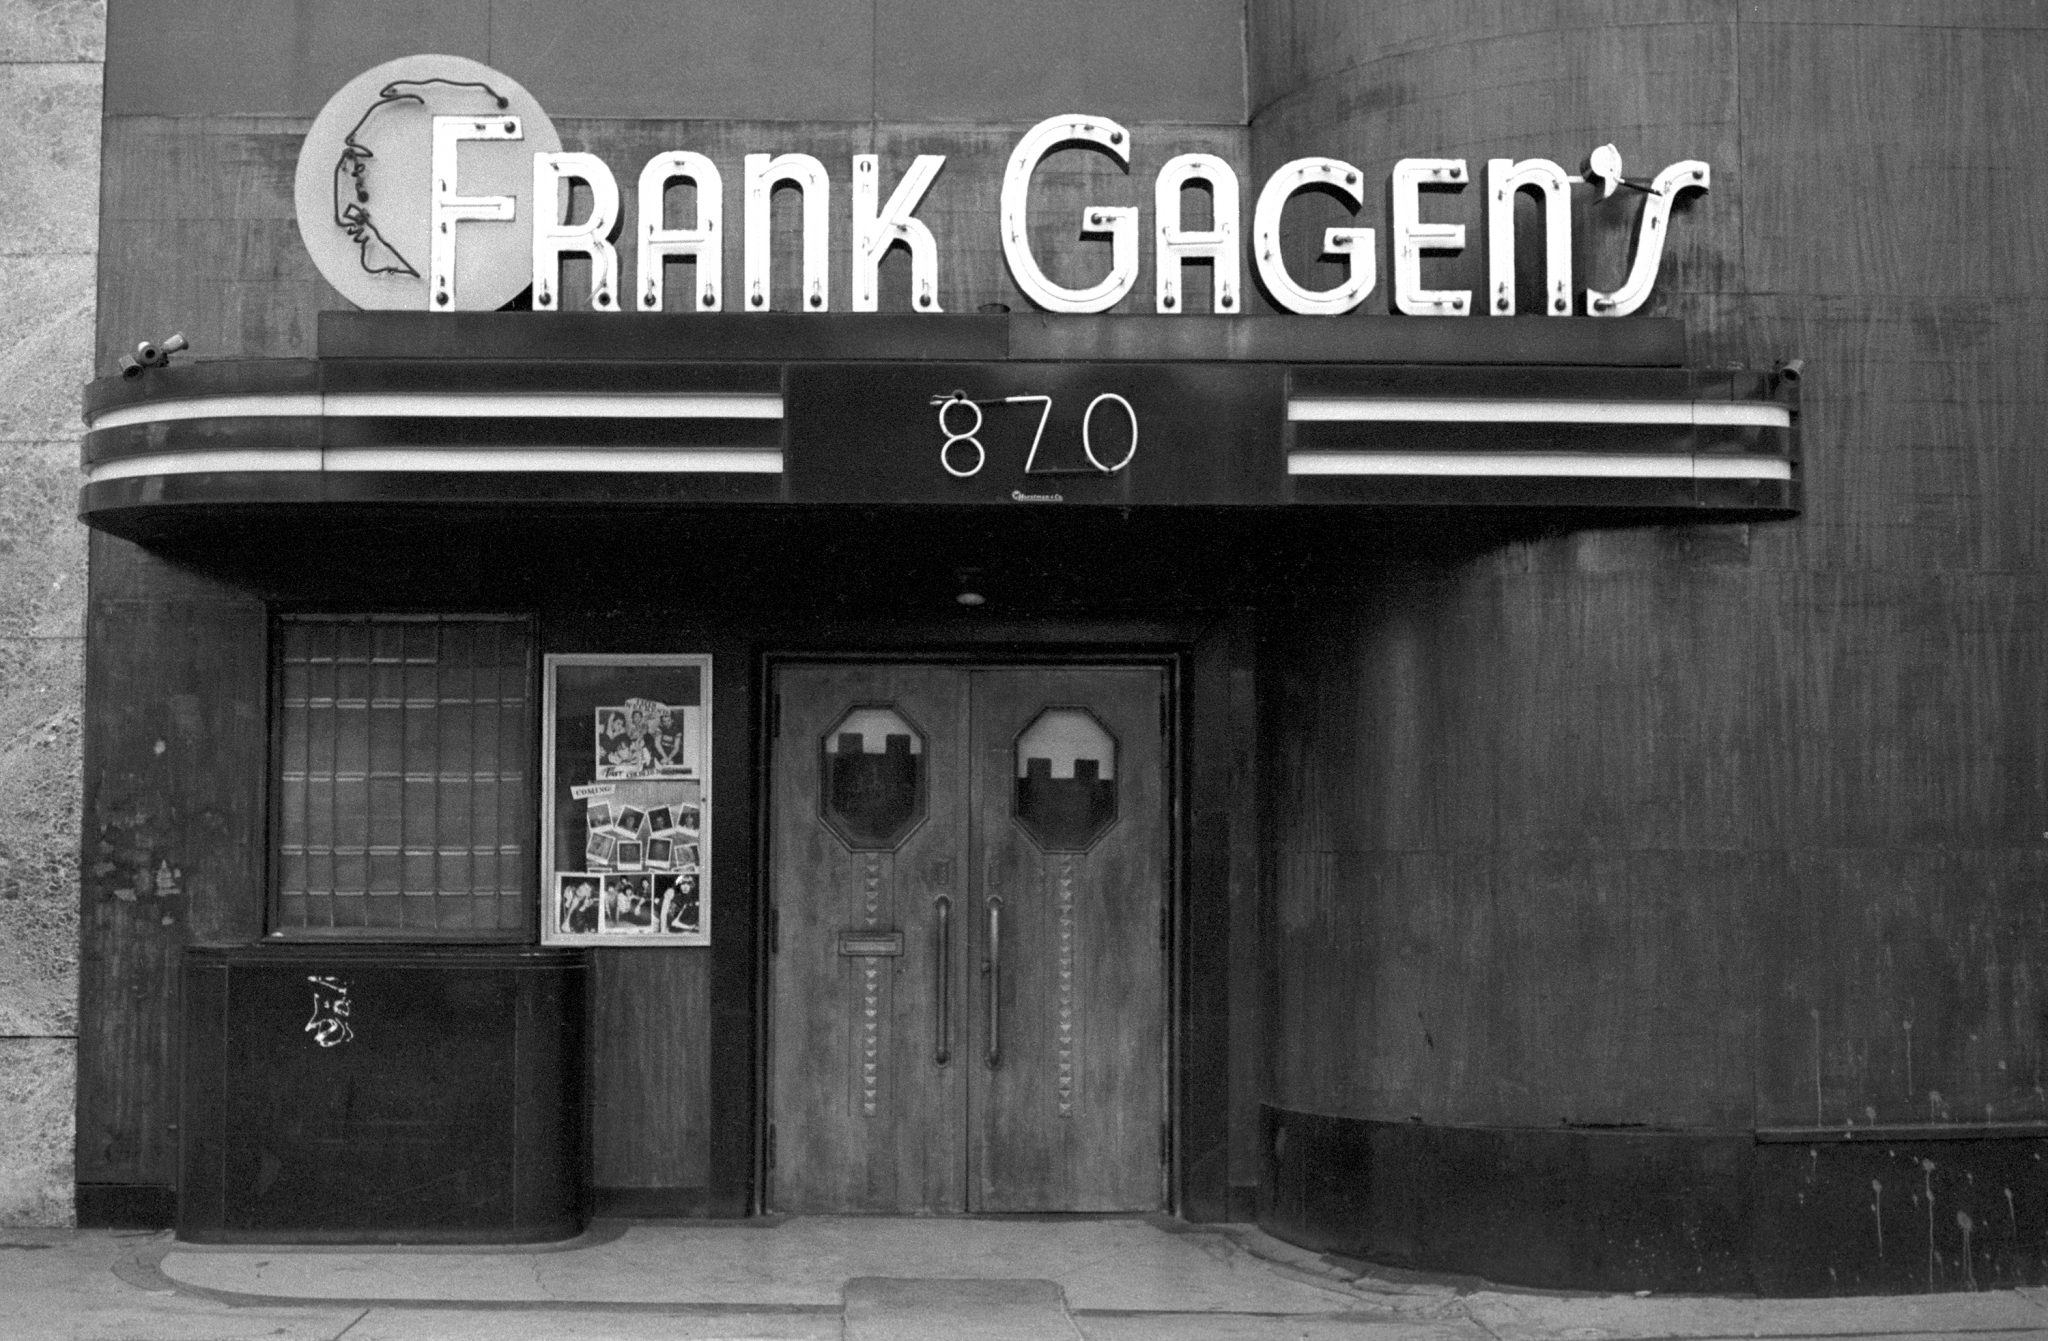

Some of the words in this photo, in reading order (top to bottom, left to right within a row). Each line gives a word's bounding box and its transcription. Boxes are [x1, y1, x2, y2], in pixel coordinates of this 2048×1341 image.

[429, 114, 944, 313] FRANK
[938, 392, 1139, 478] 870
[575, 786, 611, 796] COMING
